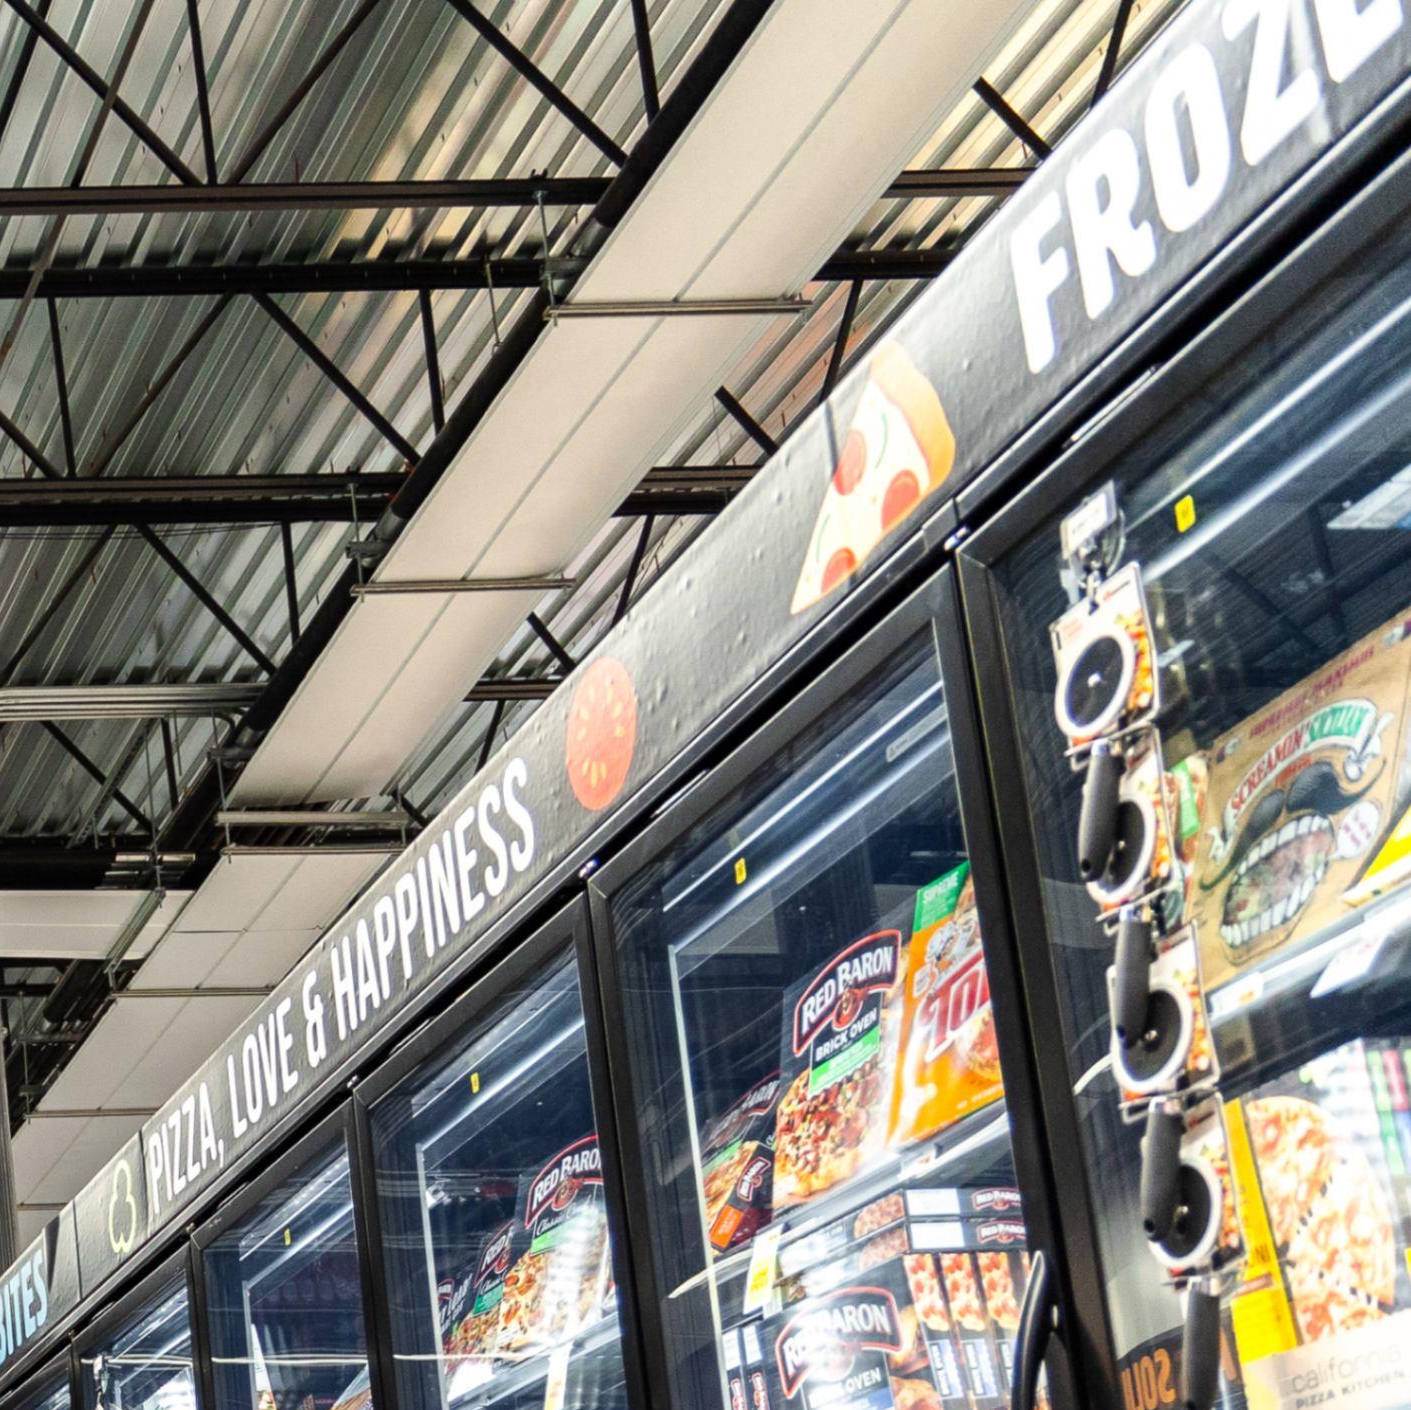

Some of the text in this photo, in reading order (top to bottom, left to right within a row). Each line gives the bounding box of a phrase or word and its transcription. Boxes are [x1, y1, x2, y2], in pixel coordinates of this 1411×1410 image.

[146, 755, 536, 1216] PIZZA, LOVE & HAPPINESS
[800, 947, 893, 1034] RED BARON
[816, 1008, 877, 1060] BRICK OVEN
[531, 1169, 558, 1210] RED
[812, 1304, 892, 1335] ARON
[844, 1368, 882, 1394] OVEN
[1296, 1390, 1336, 1410] PIZZA
